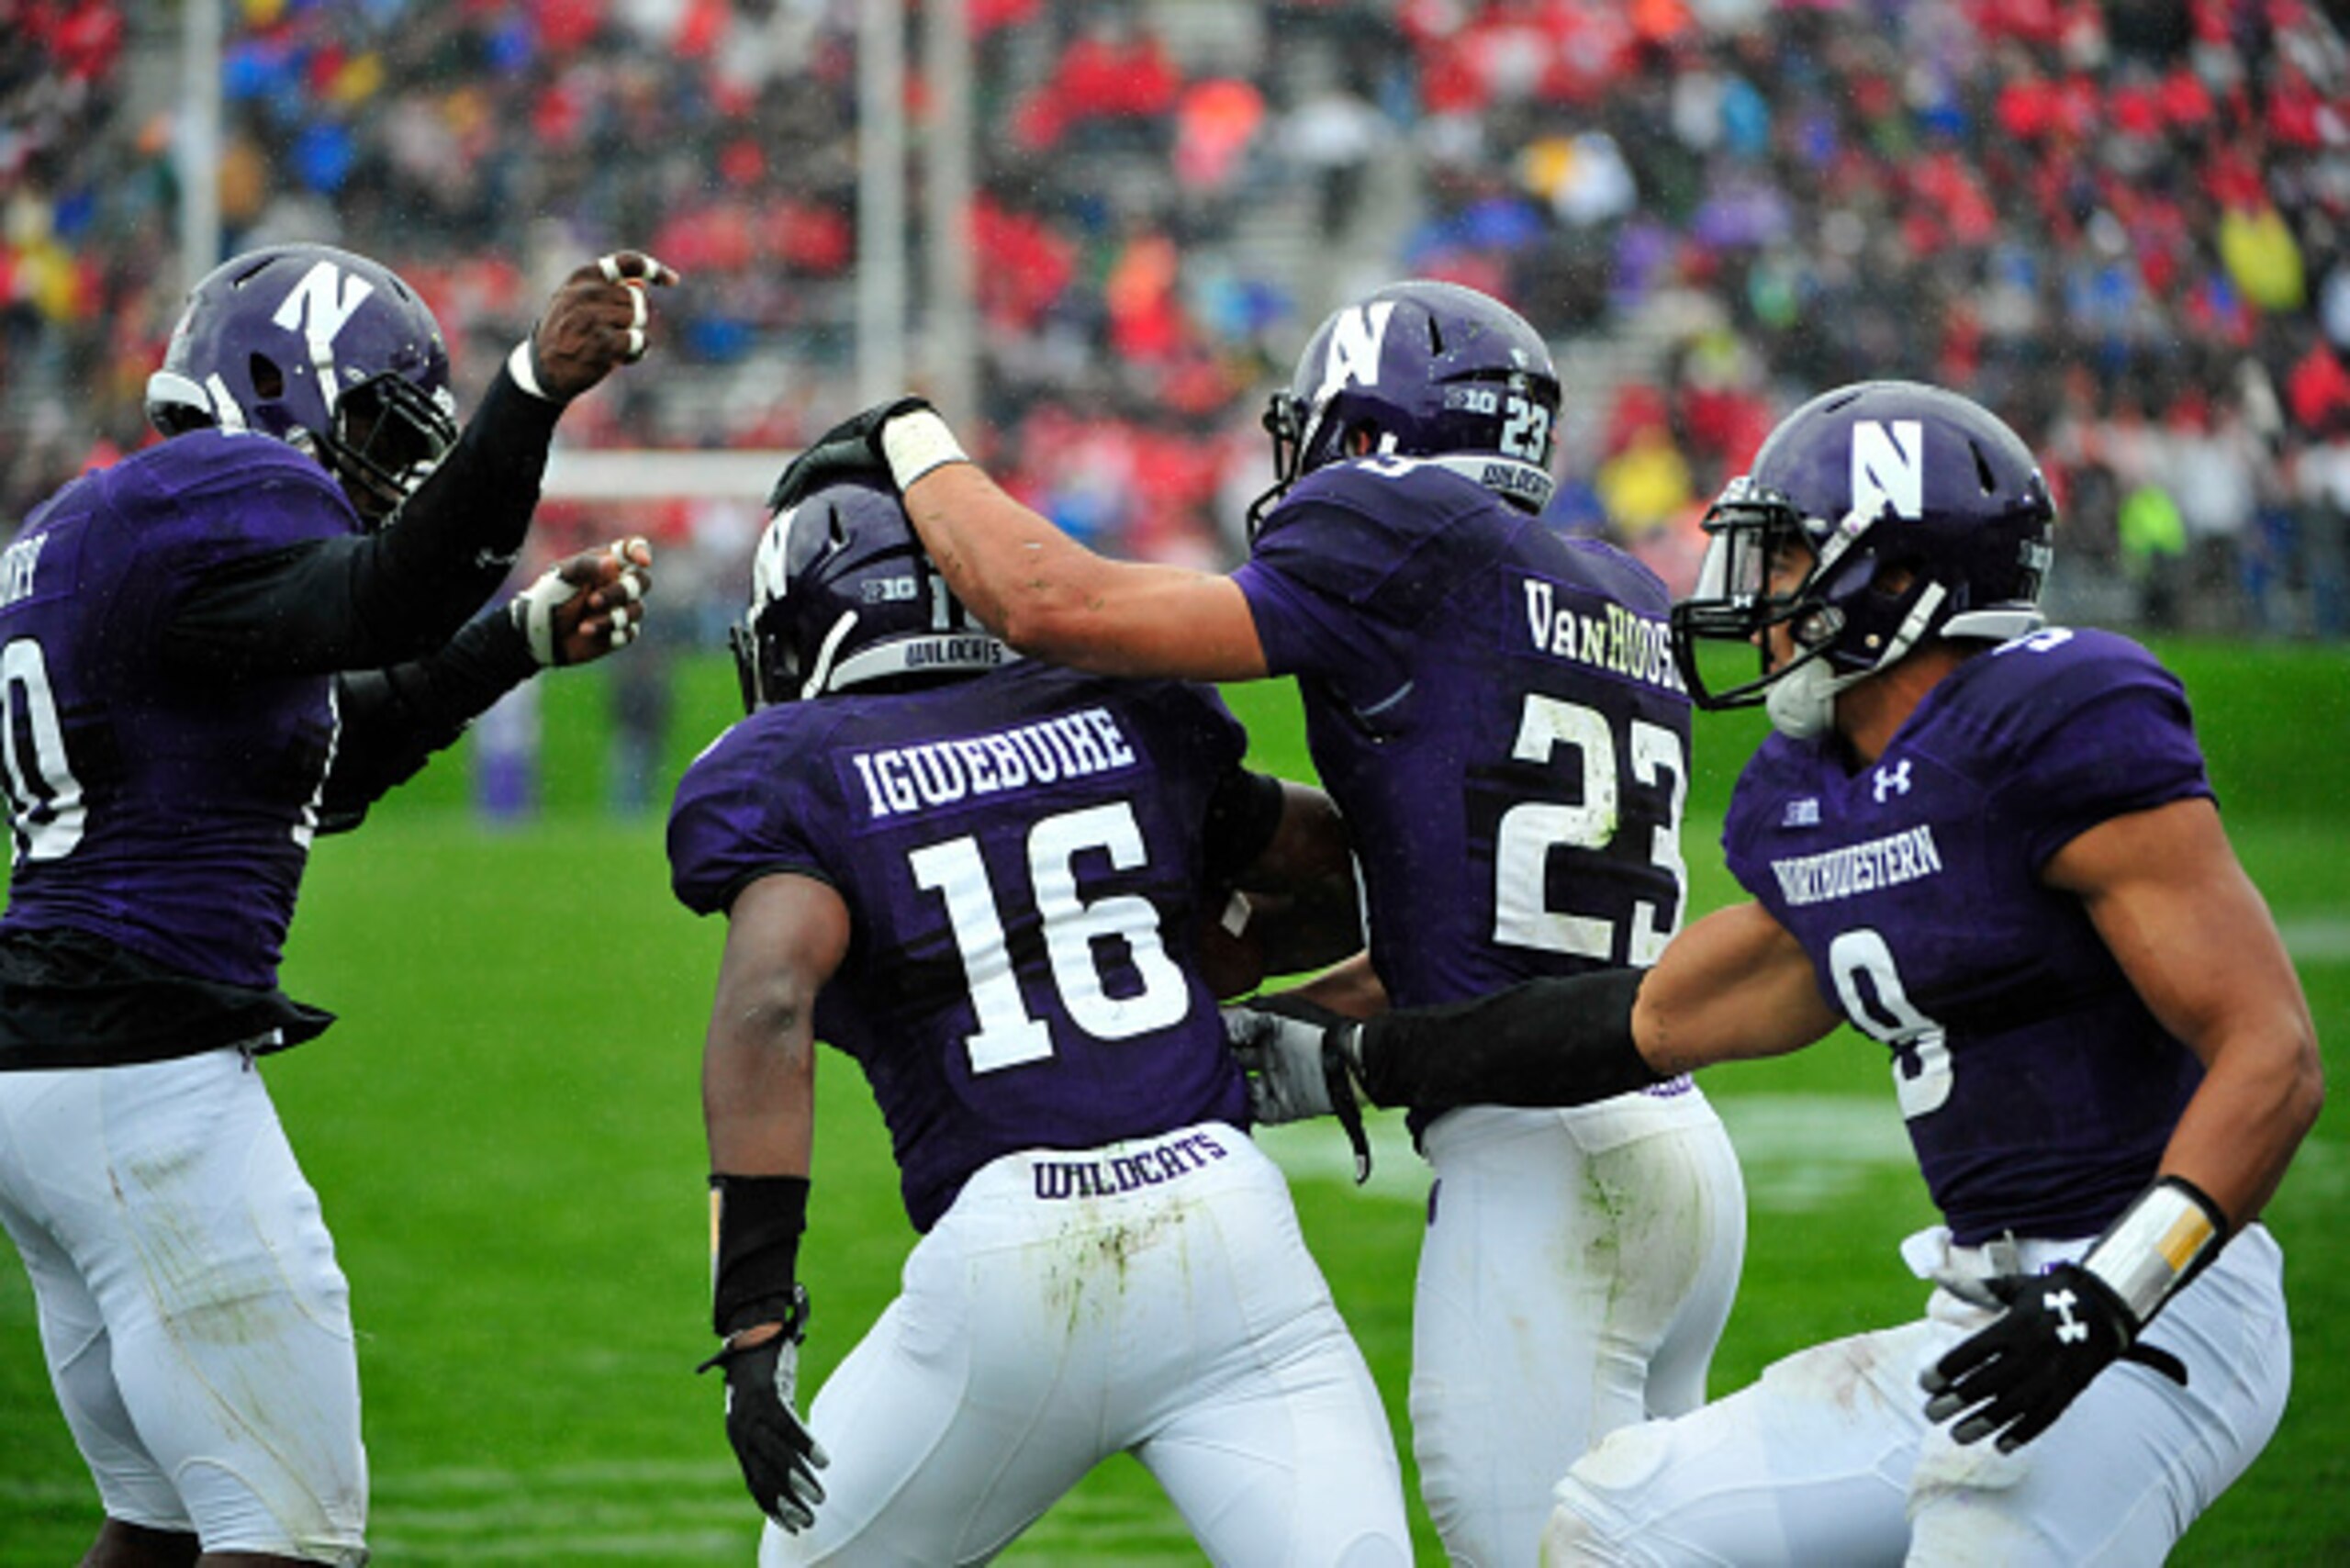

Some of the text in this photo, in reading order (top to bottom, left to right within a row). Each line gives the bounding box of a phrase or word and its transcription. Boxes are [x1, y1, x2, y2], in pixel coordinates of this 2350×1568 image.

[273, 260, 375, 342] N
[1325, 300, 1396, 386] N
[1499, 396, 1549, 462] 23
[1852, 420, 1922, 520] N
[904, 640, 1002, 667] WILDCATS
[0, 638, 87, 868] 0
[854, 708, 1136, 818] IGWEBUIHE
[1493, 692, 1689, 968] 23
[1771, 824, 1942, 905] NORTHWESTERN
[908, 801, 1191, 1074] 16
[1032, 1132, 1229, 1199] WILDCATS
